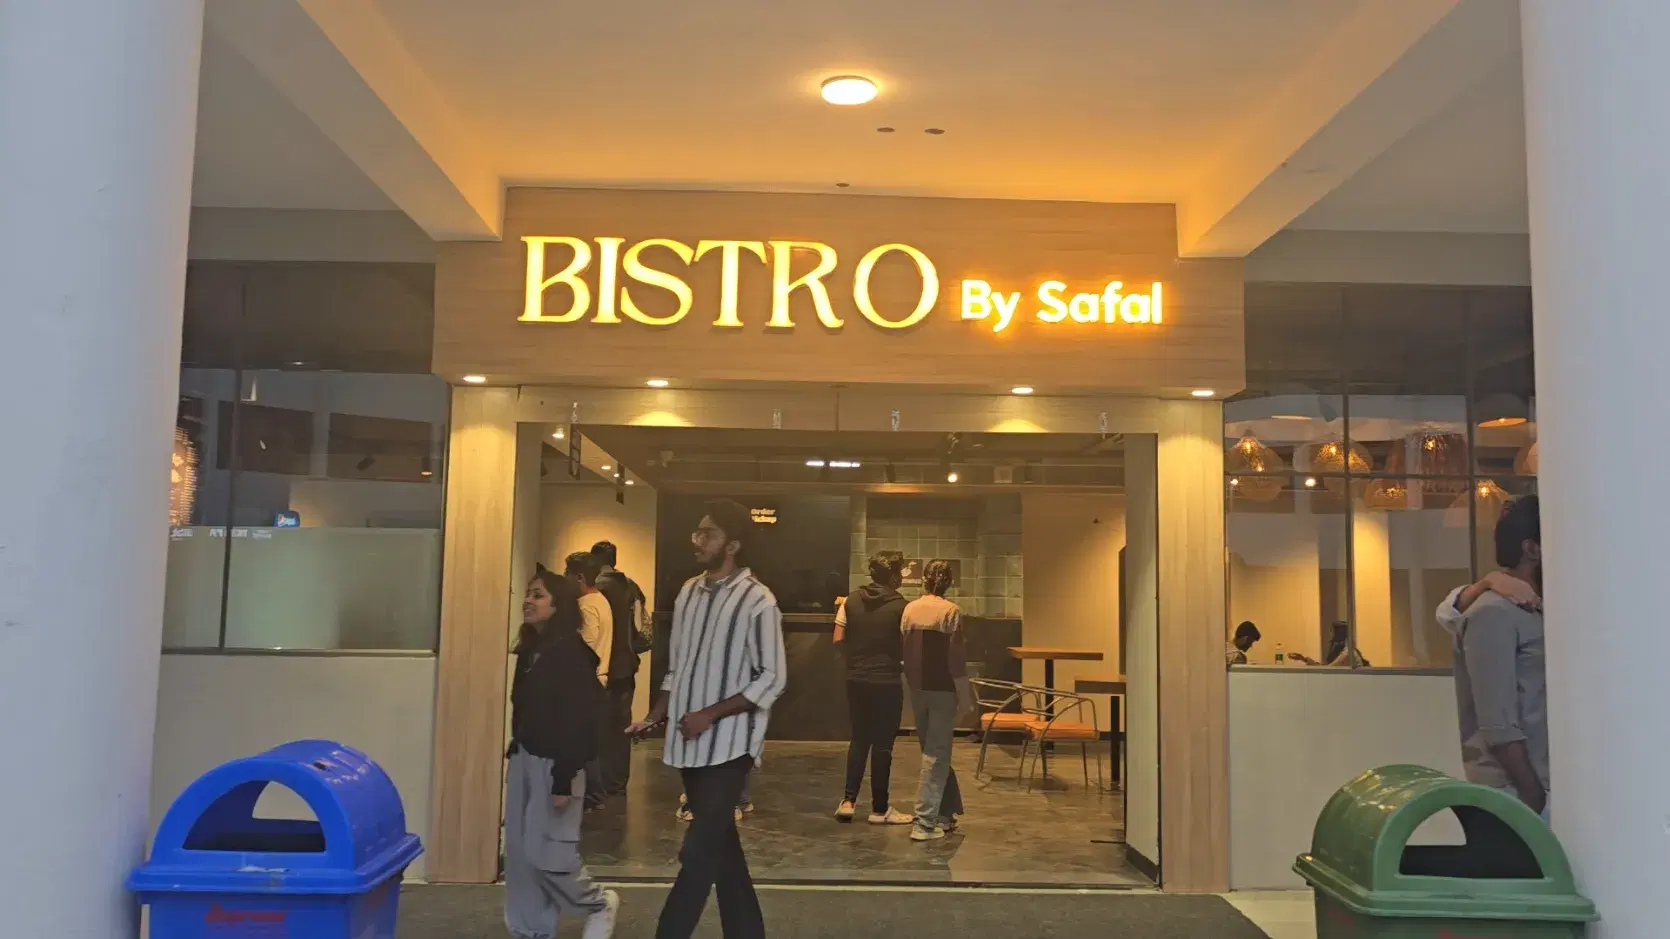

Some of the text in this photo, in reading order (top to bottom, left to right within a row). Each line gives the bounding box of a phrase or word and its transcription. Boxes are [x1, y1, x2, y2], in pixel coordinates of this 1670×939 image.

[517, 236, 1163, 332] BISTRO By Safal
